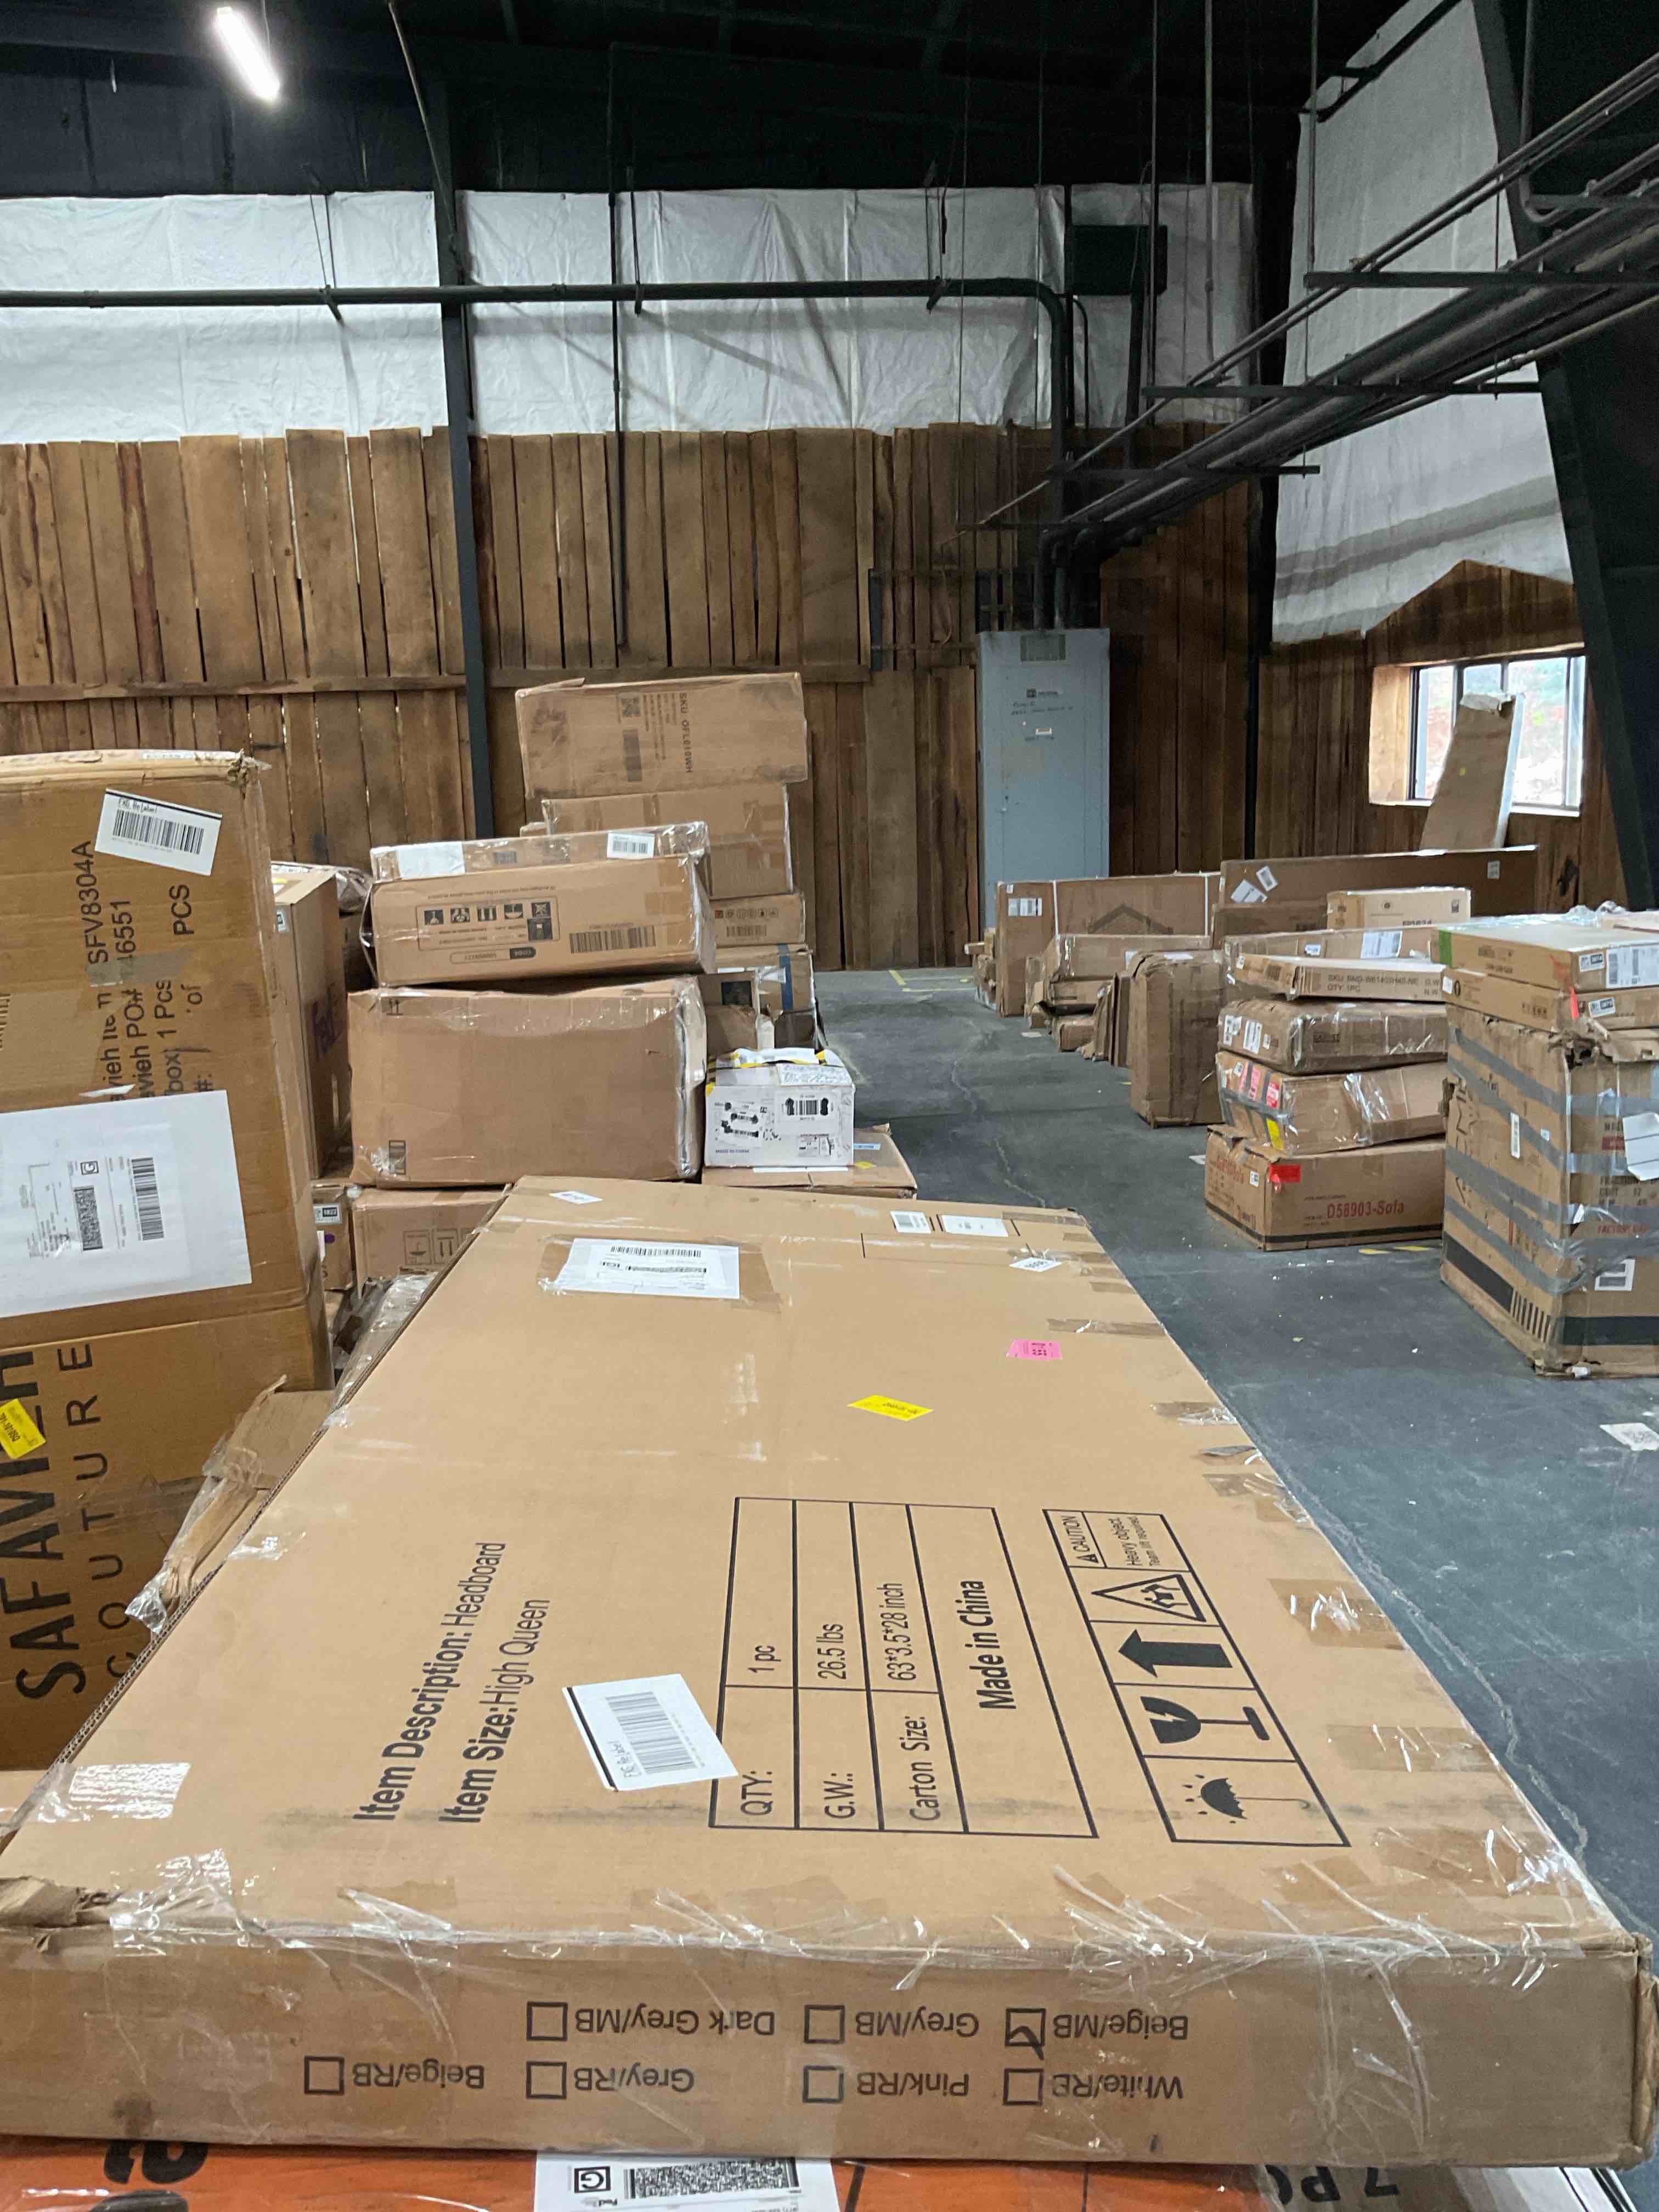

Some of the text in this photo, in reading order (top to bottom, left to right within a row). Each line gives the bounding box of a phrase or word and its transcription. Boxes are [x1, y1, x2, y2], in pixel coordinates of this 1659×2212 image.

[72, 841, 108, 964] SFV8304A
[169, 884, 195, 935] PCS
[0, 1348, 86, 1700] SAFAVIH
[57, 1343, 134, 1680] COUTURE
[1062, 1515, 1091, 1552] CAUTION
[877, 1582, 906, 1609] inch
[816, 1623, 844, 1644] lbs
[955, 1580, 1017, 1709] Made in China
[754, 1645, 782, 1662] pc
[817, 1647, 847, 1680] 26.5
[352, 1542, 506, 1821] Item Description: Headboard
[438, 1769, 498, 1823] Item
[499, 1599, 550, 1656] Queen
[900, 1716, 930, 1752] Size:
[740, 1770, 774, 1816] QTY:
[909, 1762, 941, 1822] Carton
[574, 2003, 775, 2037] Dark Grey/MB
[856, 2006, 980, 2038] Grey/MB
[1053, 2008, 1189, 2040] Beige/MB
[352, 2058, 486, 2089] Beige/RB
[573, 2061, 695, 2091] Grey/RB
[857, 2072, 970, 2097] Pink/RB
